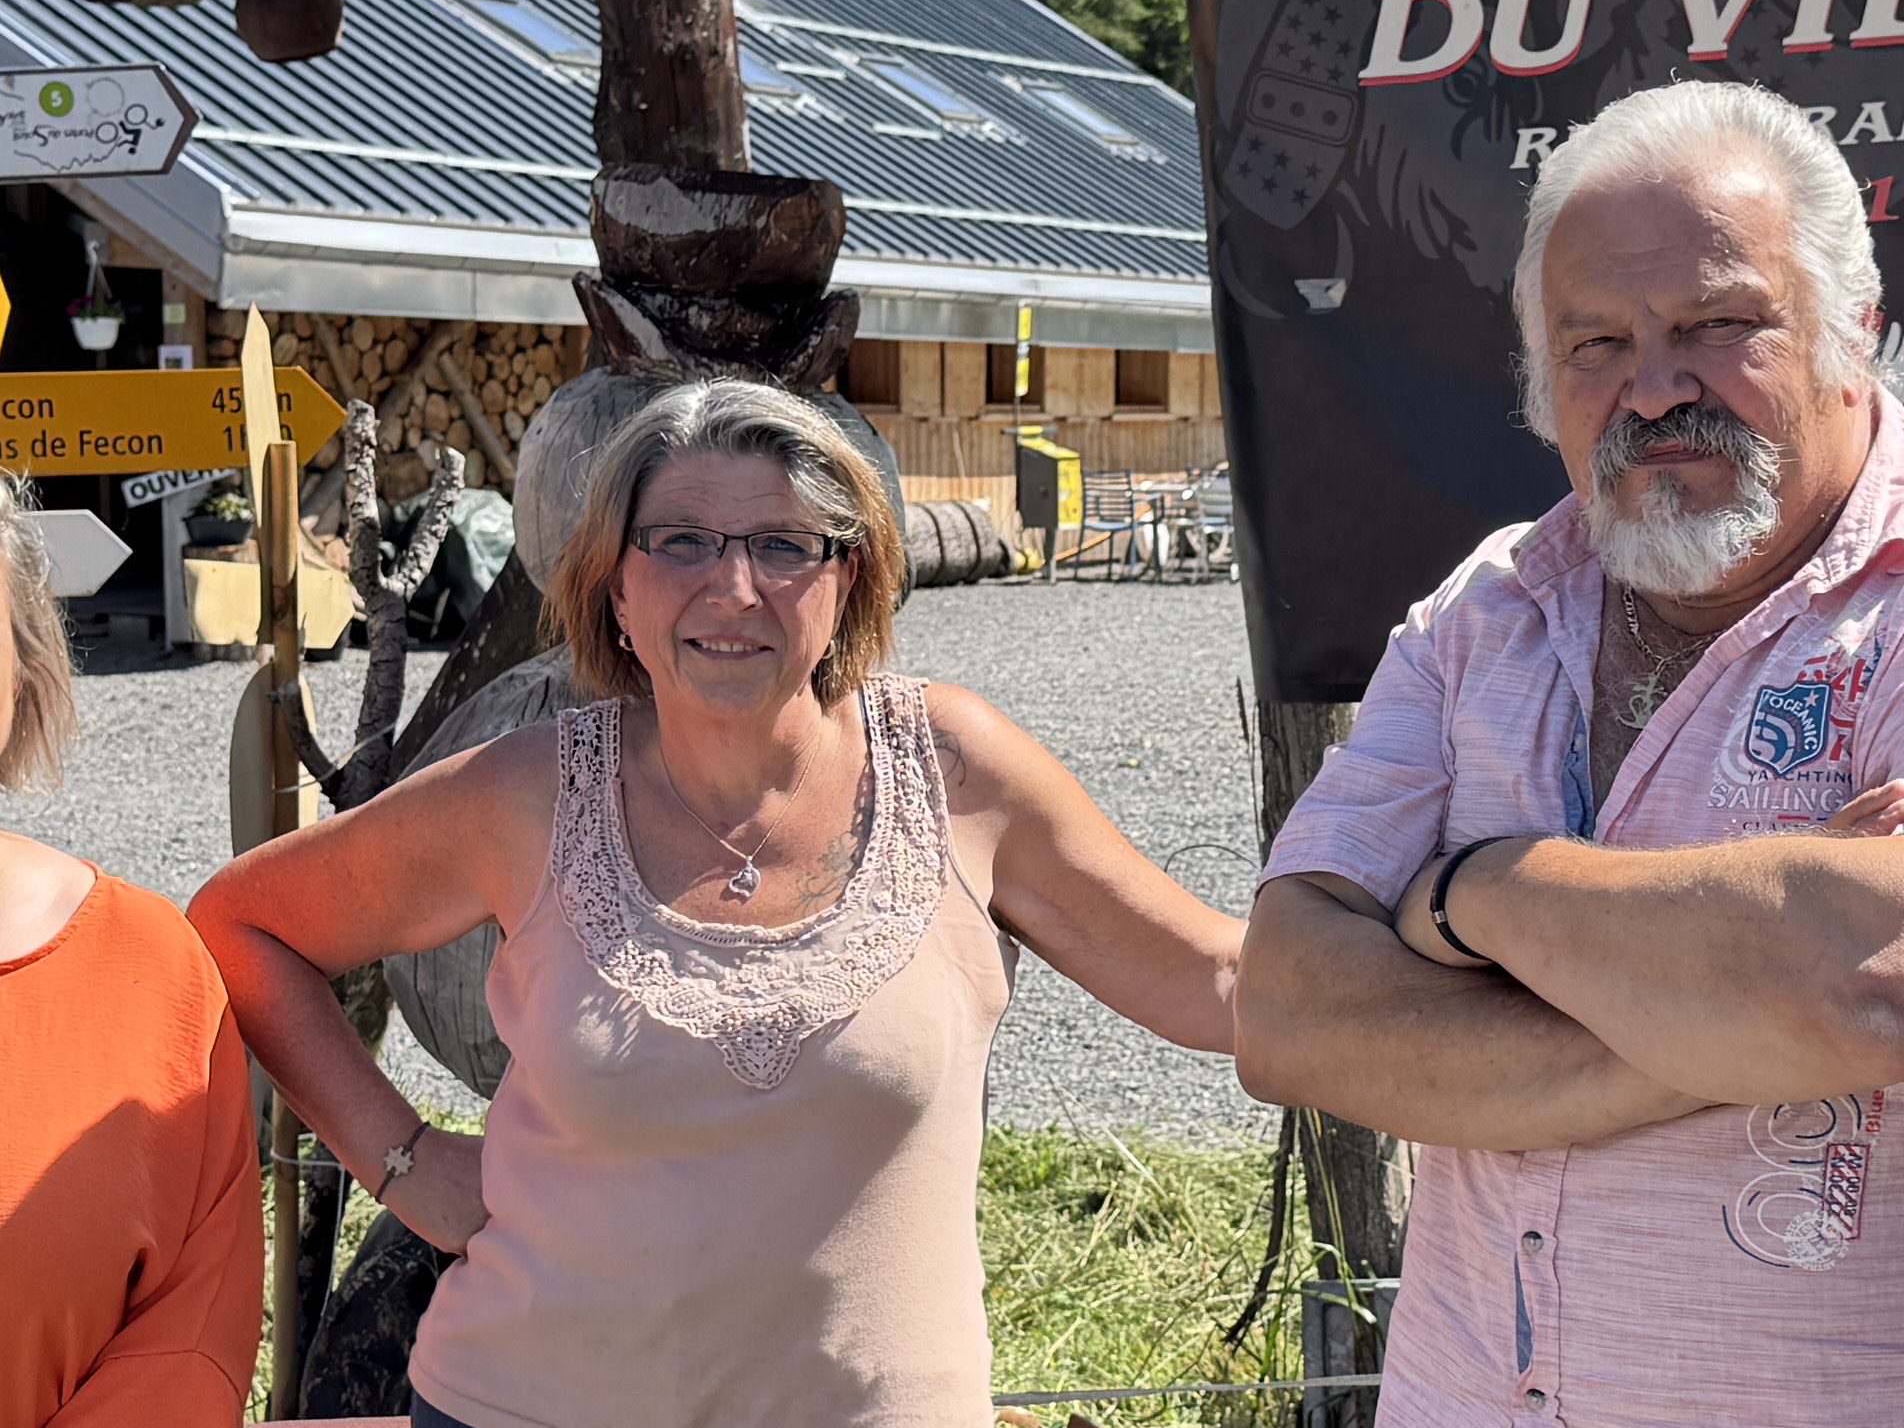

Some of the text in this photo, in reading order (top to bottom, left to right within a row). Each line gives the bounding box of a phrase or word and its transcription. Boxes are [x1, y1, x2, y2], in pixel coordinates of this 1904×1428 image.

[51, 92, 63, 108] 5
[211, 387, 292, 414] 45n
[31, 429, 67, 458] de
[78, 429, 163, 458] Fecon
[1769, 695, 1819, 751] OCEANIC
[1706, 783, 1845, 813] SAILING
[1864, 1089, 1885, 1133] Blue
